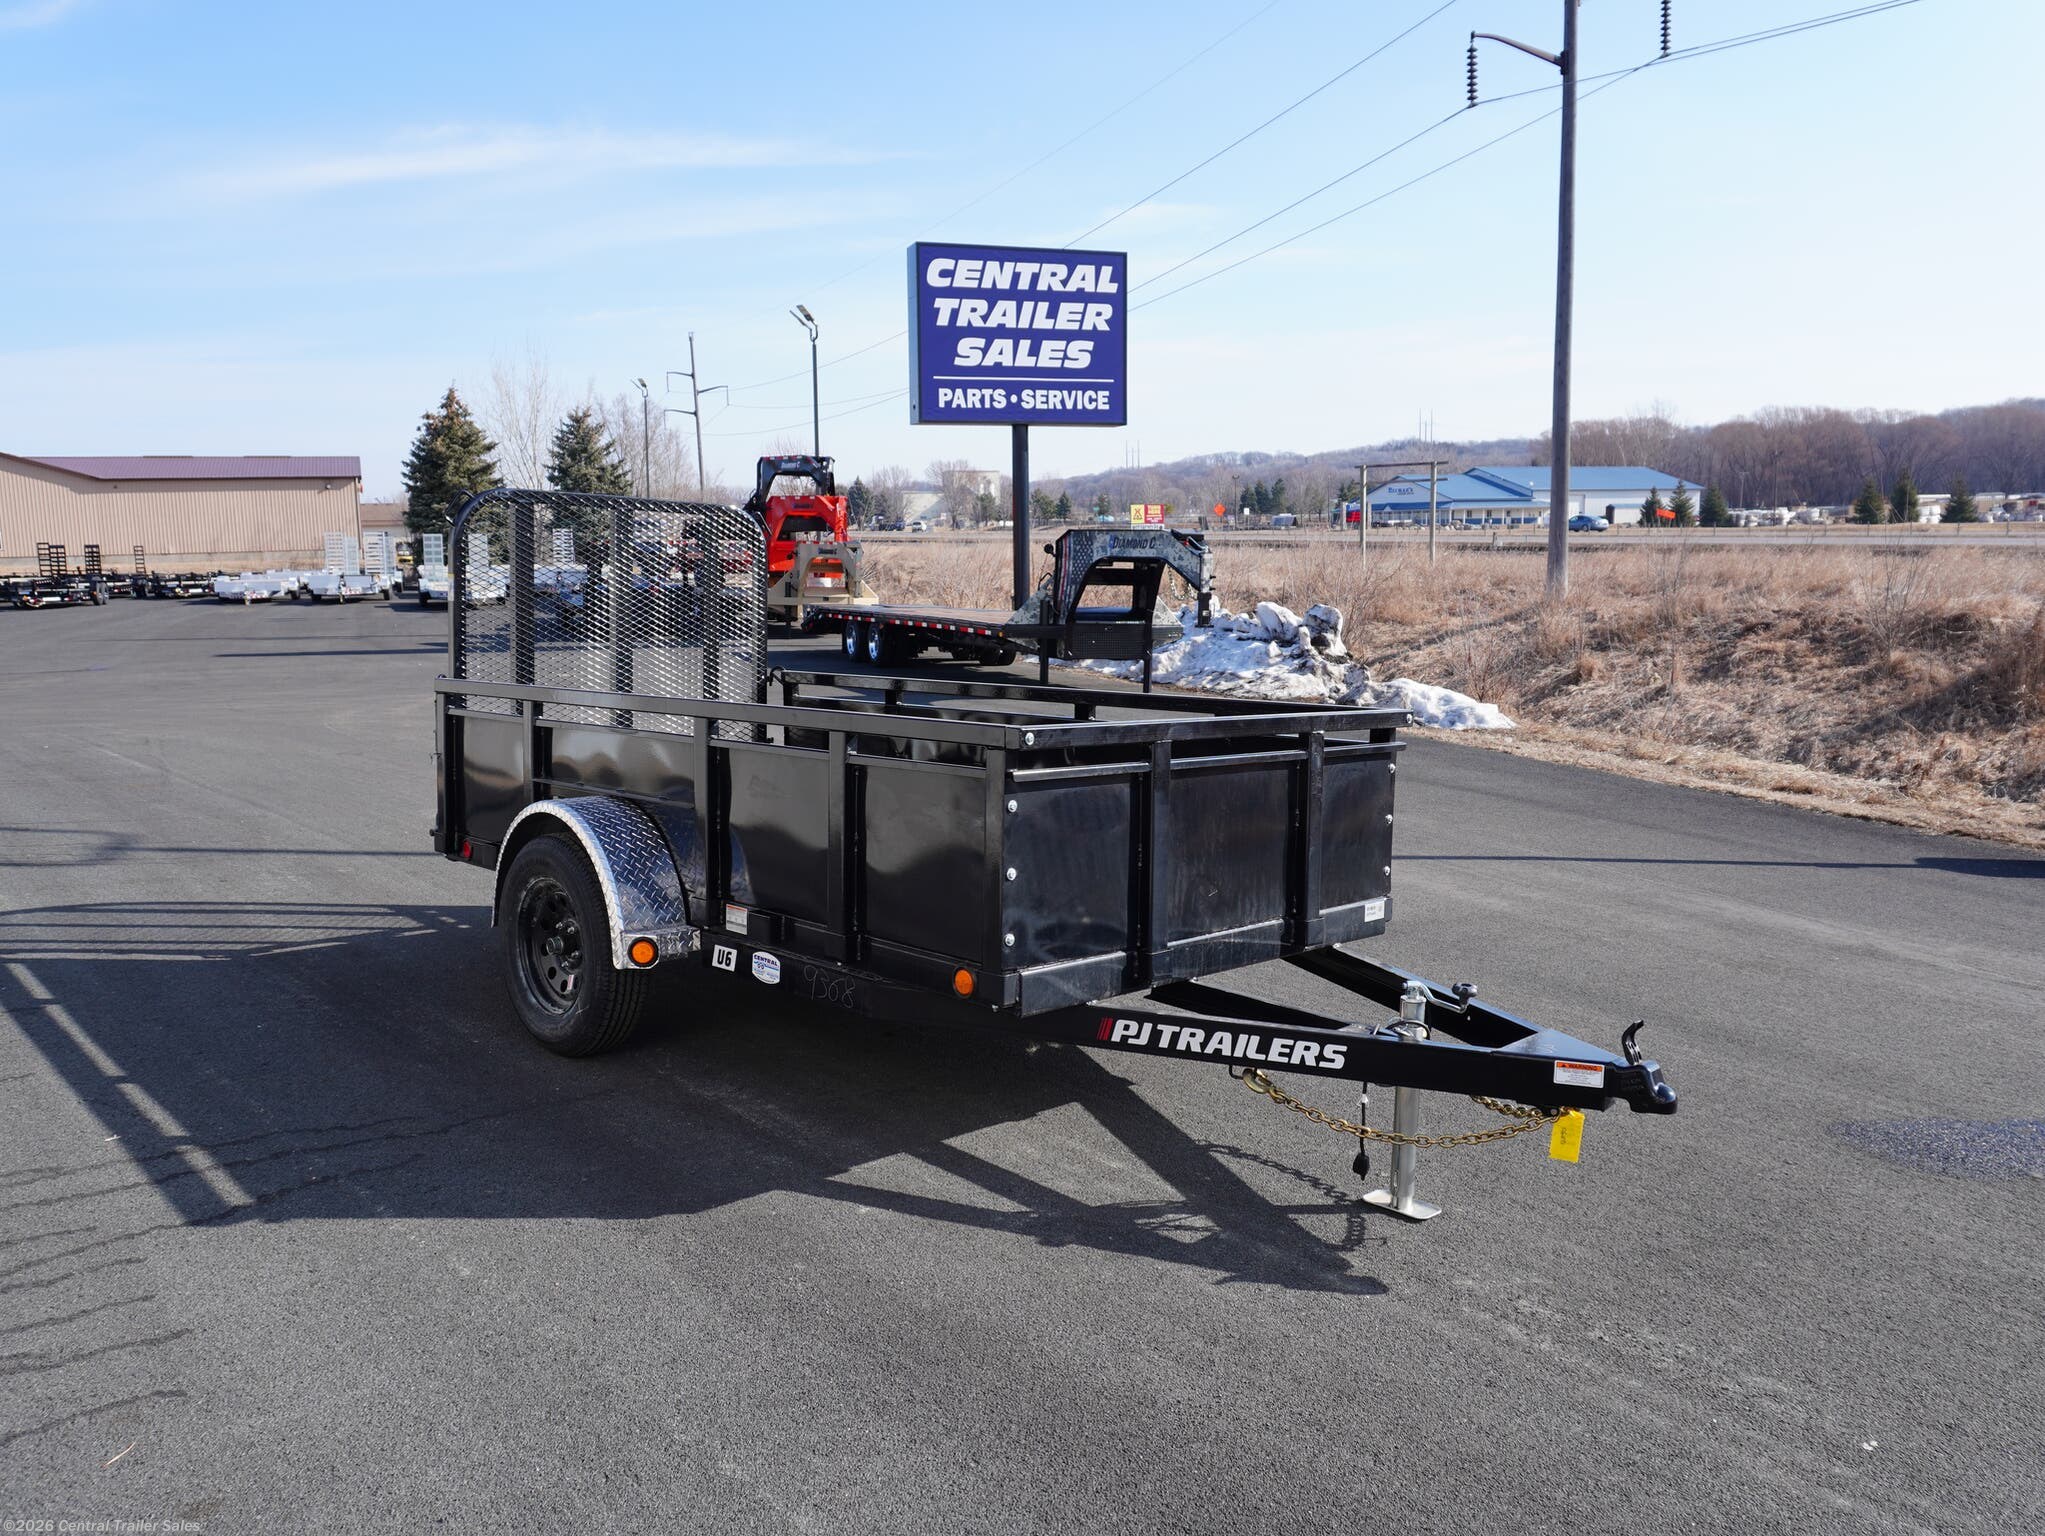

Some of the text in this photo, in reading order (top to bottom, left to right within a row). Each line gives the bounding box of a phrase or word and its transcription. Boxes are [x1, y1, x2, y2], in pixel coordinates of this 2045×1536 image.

[926, 258, 1119, 293] CENTRAL
[933, 298, 1113, 331] TRAILER
[954, 337, 1094, 369] SALES
[716, 948, 733, 967] U6
[754, 954, 778, 966] CENTRAL
[1111, 1019, 1348, 1070] PJ TRAILERS
